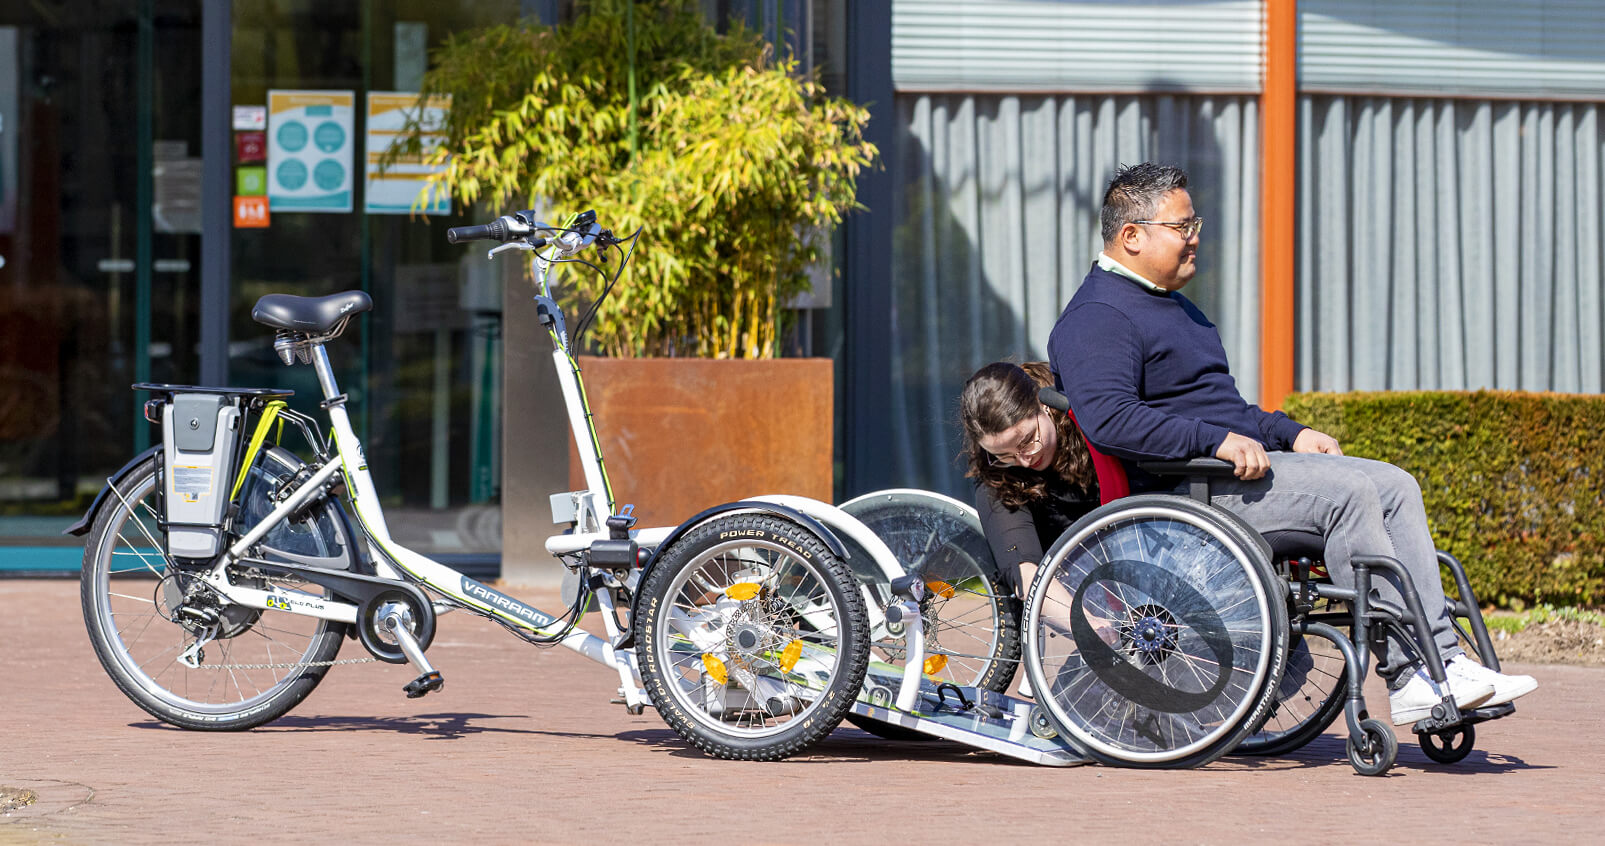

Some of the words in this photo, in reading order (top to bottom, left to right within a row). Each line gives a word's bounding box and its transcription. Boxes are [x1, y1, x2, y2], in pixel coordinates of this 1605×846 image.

[720, 529, 765, 539] POWER
[771, 533, 813, 559] TREAD
[305, 602, 325, 610] PLUS
[1023, 554, 1052, 644] SCHWALBE
[645, 597, 658, 673] ROADSTAR
[654, 678, 696, 729] SWALLOW
[1243, 680, 1276, 730] MARATHON
[1272, 647, 1283, 677] PLUS
